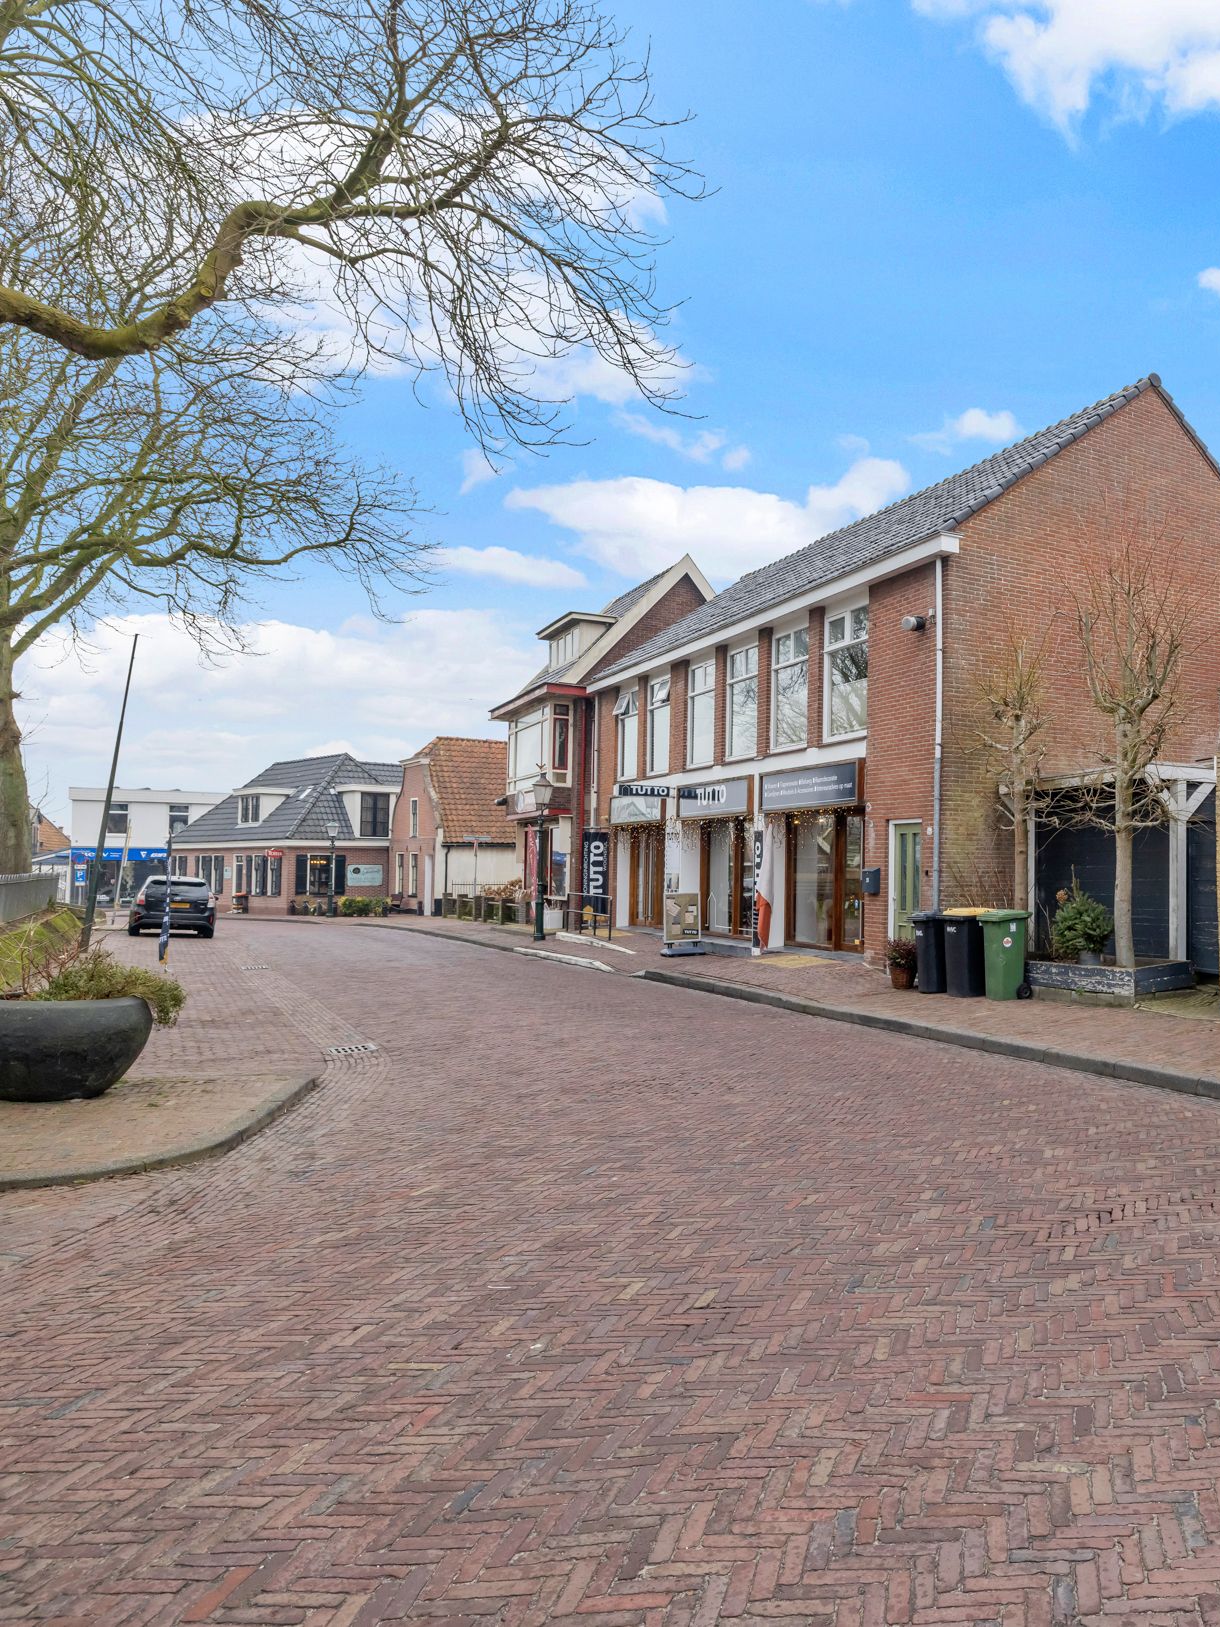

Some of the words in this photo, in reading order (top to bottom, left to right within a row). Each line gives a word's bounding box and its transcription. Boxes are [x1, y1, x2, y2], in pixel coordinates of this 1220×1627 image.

[631, 785, 667, 796] TUTTO
[696, 785, 727, 806] TUTTO
[590, 841, 604, 895] TUTTO
